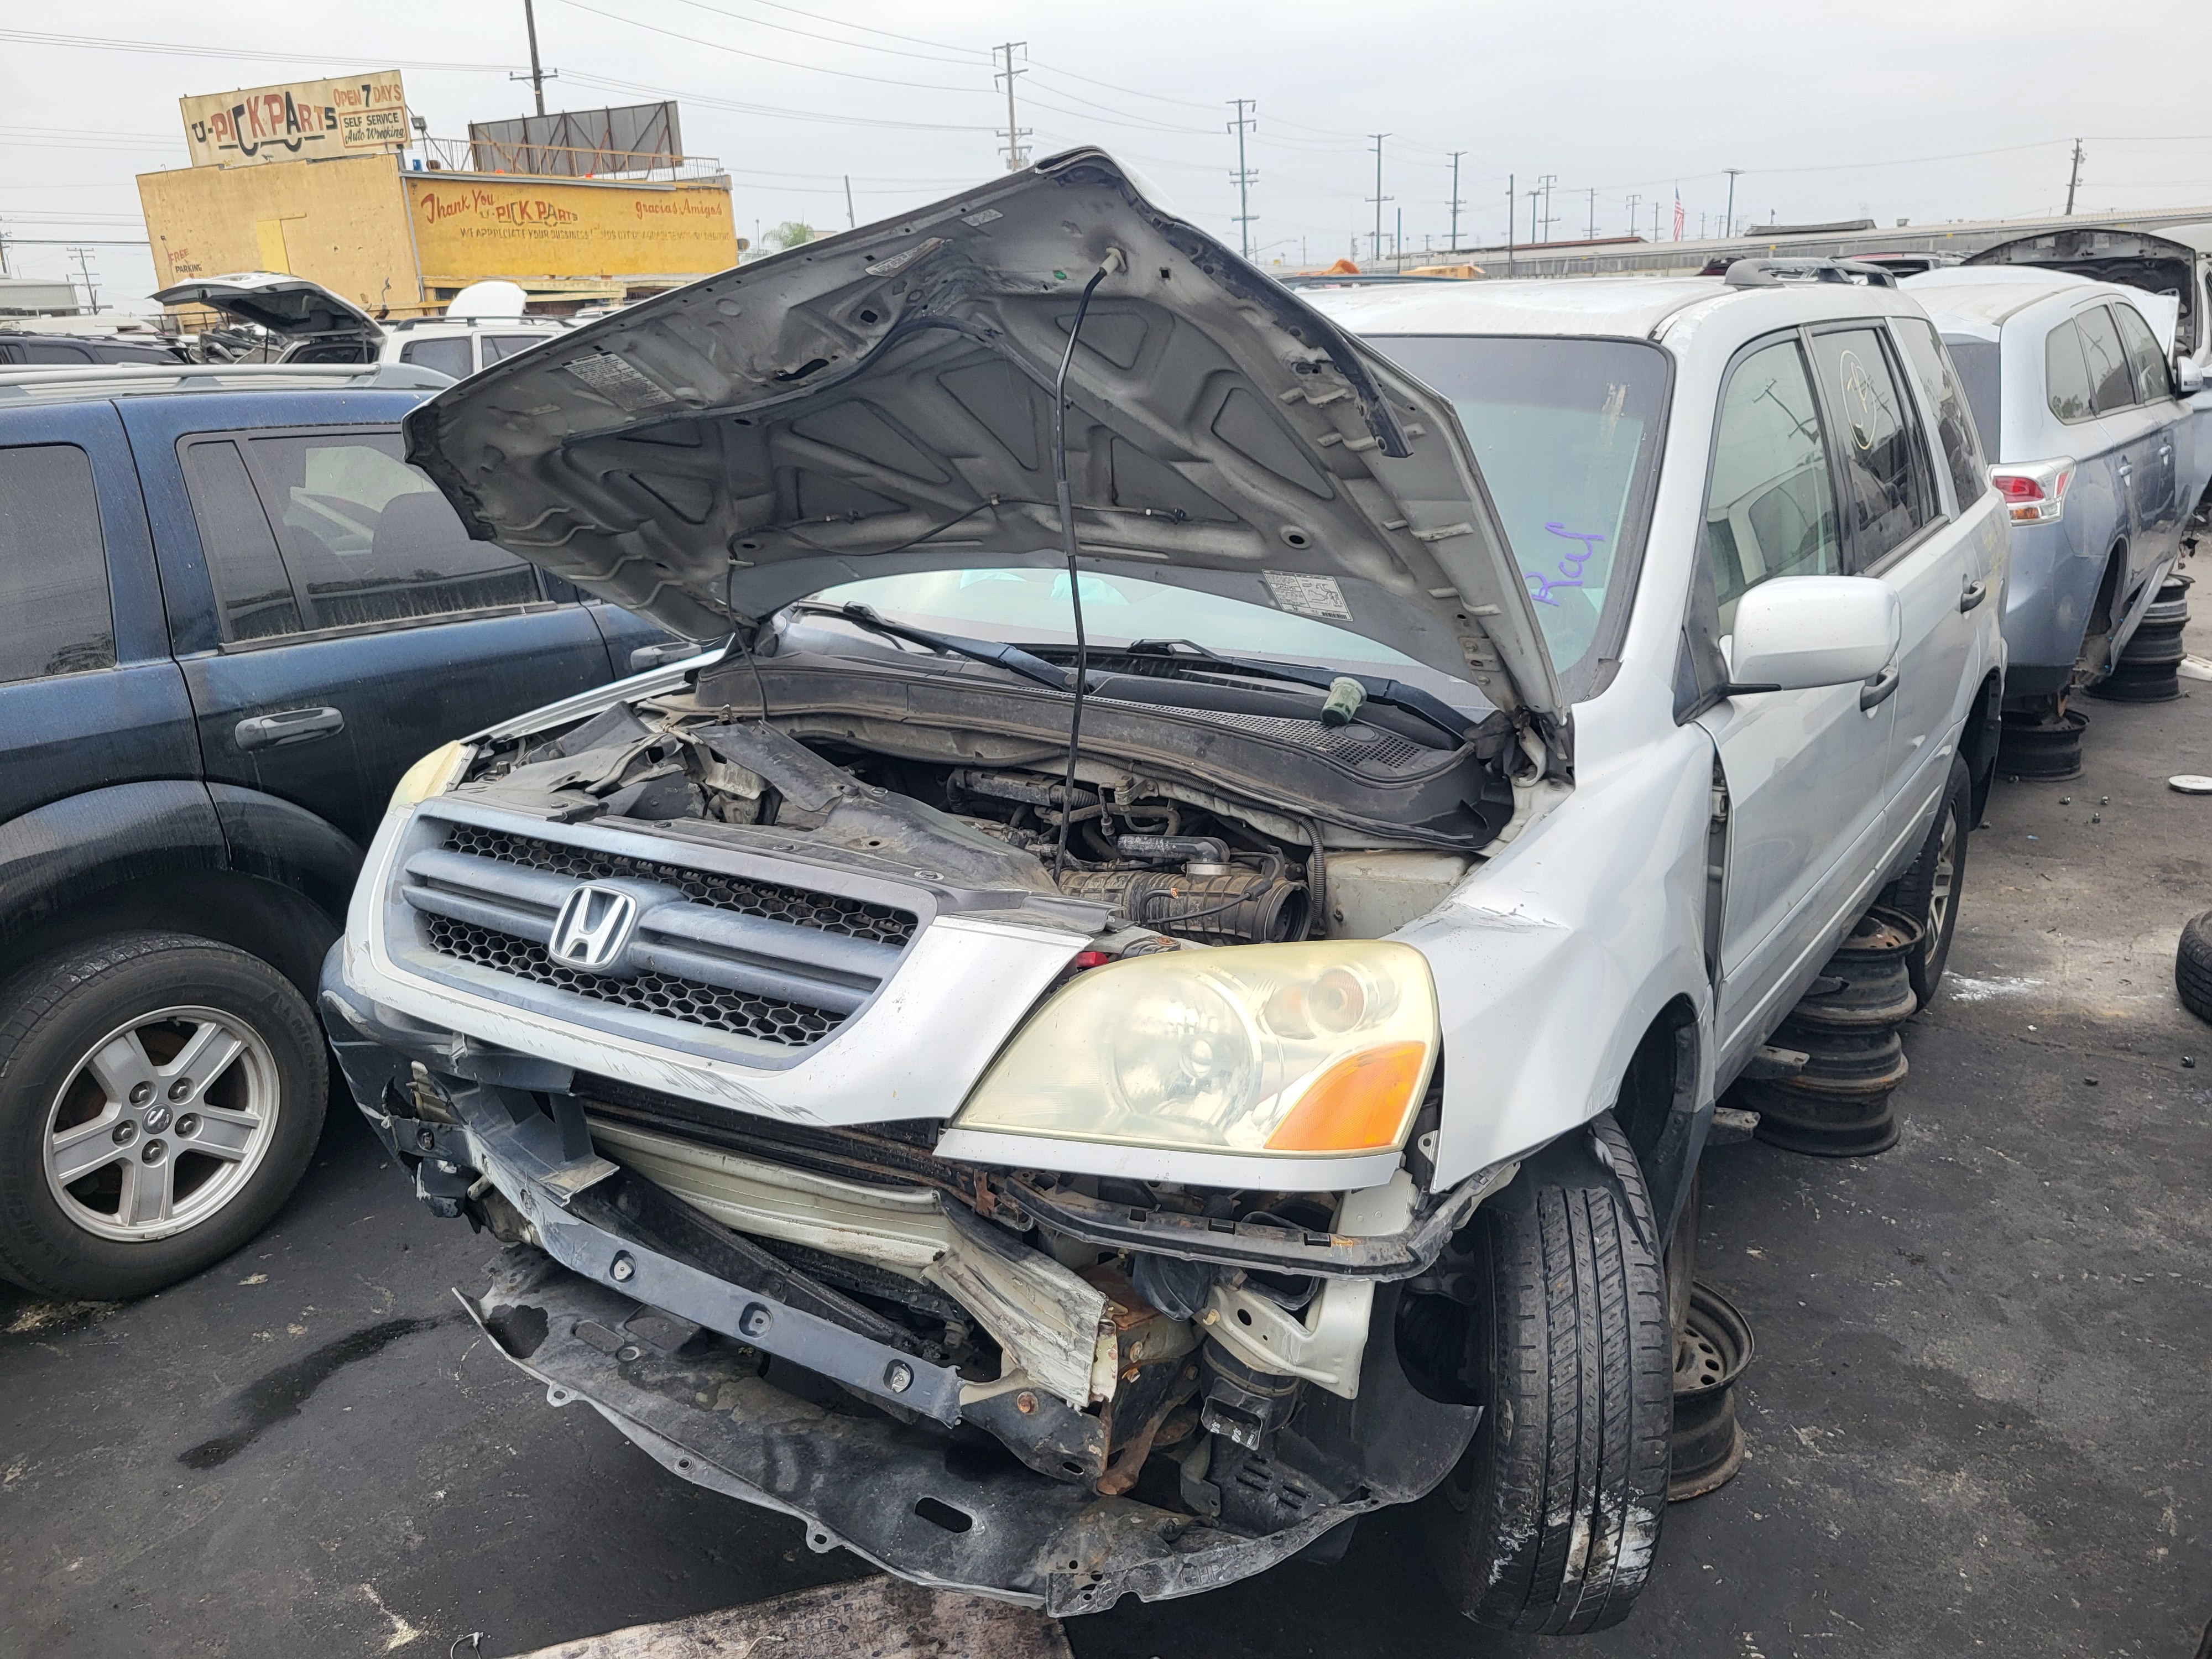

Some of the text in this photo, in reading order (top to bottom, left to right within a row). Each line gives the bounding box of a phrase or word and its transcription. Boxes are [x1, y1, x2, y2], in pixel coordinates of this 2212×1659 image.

[333, 84, 402, 108] OPEN 7 DAYS
[191, 91, 338, 157] U-PICK PARTS
[343, 112, 400, 128] SELF SERVICE
[345, 125, 405, 144] Auto Wrecking
[420, 193, 471, 224] Thank
[472, 189, 495, 213] You
[535, 201, 578, 222] PARTS
[679, 198, 722, 218] Amigos
[460, 227, 473, 238] WE
[528, 229, 549, 239] YOUR
[168, 248, 190, 266] FREE
[175, 264, 203, 274] PARKING
